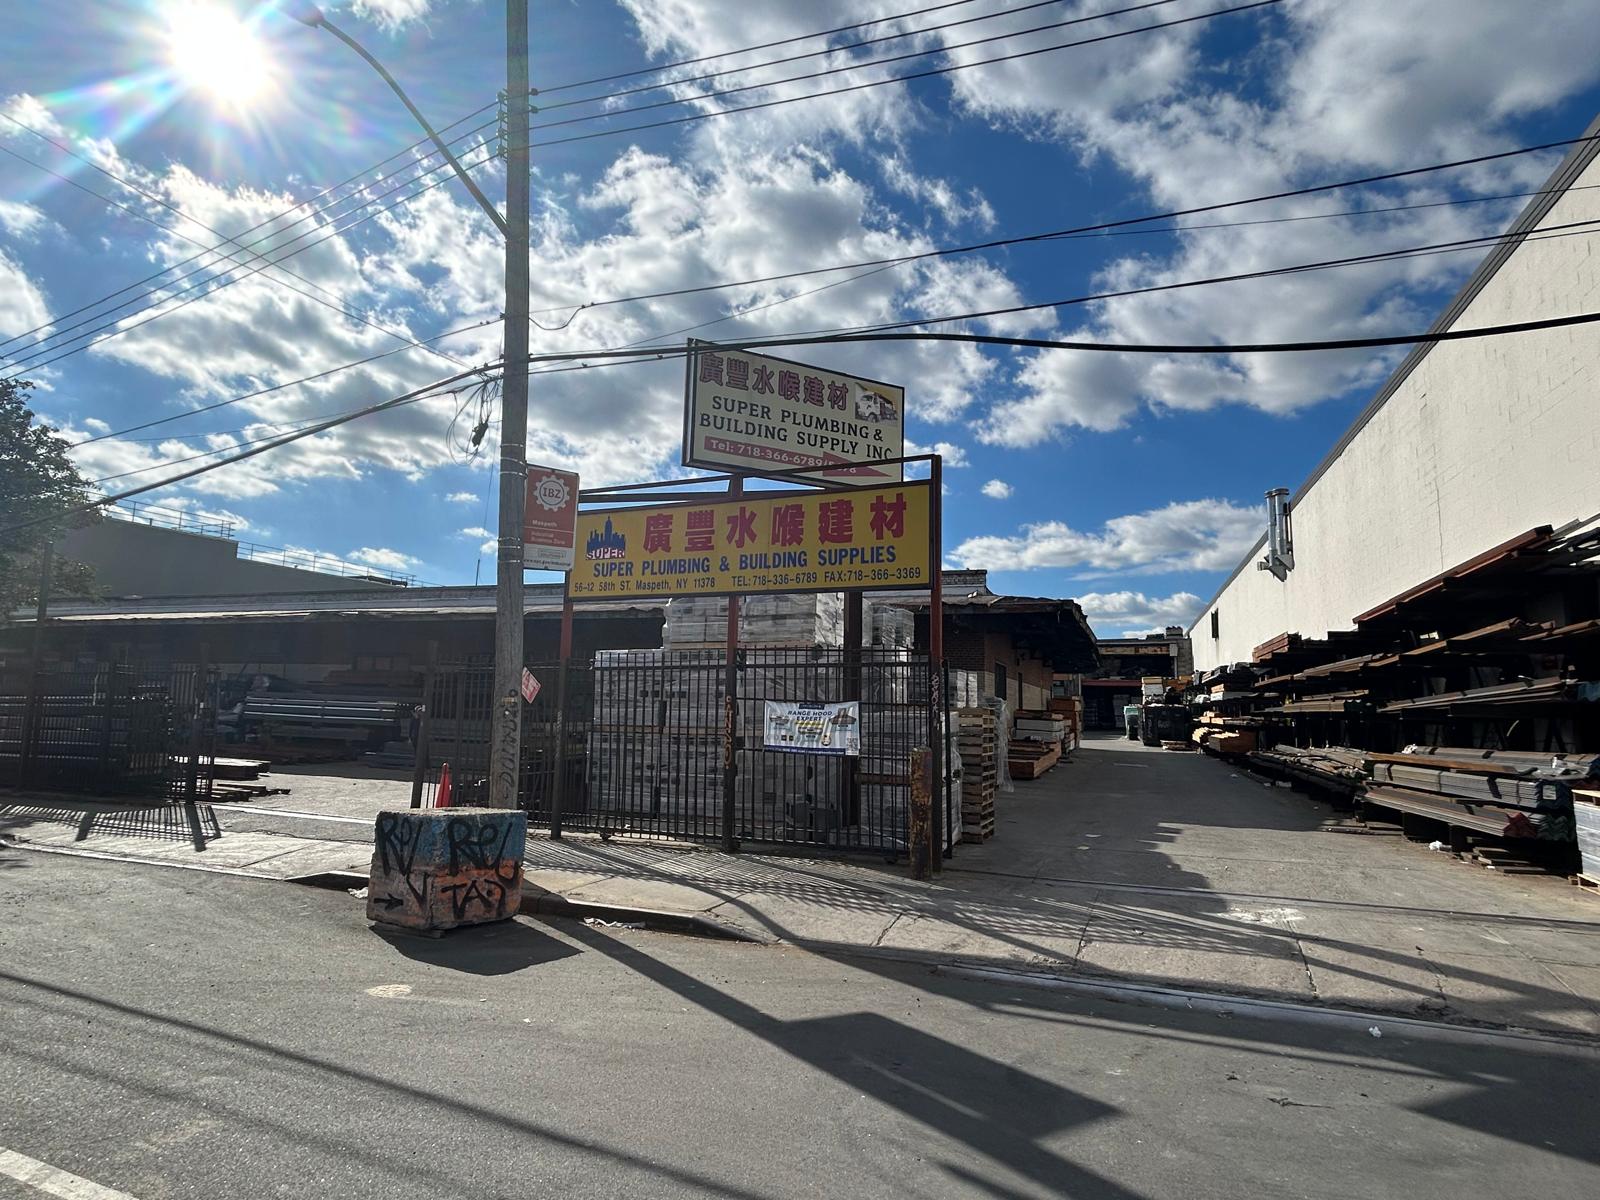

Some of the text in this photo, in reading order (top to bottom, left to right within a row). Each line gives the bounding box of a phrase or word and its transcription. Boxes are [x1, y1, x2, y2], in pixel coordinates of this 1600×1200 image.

[700, 352, 849, 411] 廣豐水喉建材
[700, 413, 788, 442] BUILDING
[797, 431, 858, 455] SUPPLY
[712, 395, 884, 442] SUPER PLUMBING &
[710, 440, 735, 451] Tel:
[543, 488, 561, 499] IBZ
[643, 493, 907, 553] 廣豐水喉建材
[586, 547, 625, 560] SUPER
[593, 561, 634, 577] SUPER
[642, 557, 711, 576] PLUMBING
[719, 555, 730, 572] &
[739, 550, 808, 570] BUILDING
[818, 545, 897, 566] SUPPLIES
[574, 580, 595, 592] 56-12
[599, 580, 616, 592] 58th
[620, 580, 632, 590] ST.
[635, 578, 672, 593] Maspeth,
[676, 578, 688, 589] NY
[824, 567, 921, 583] FAX:718-366-3369
